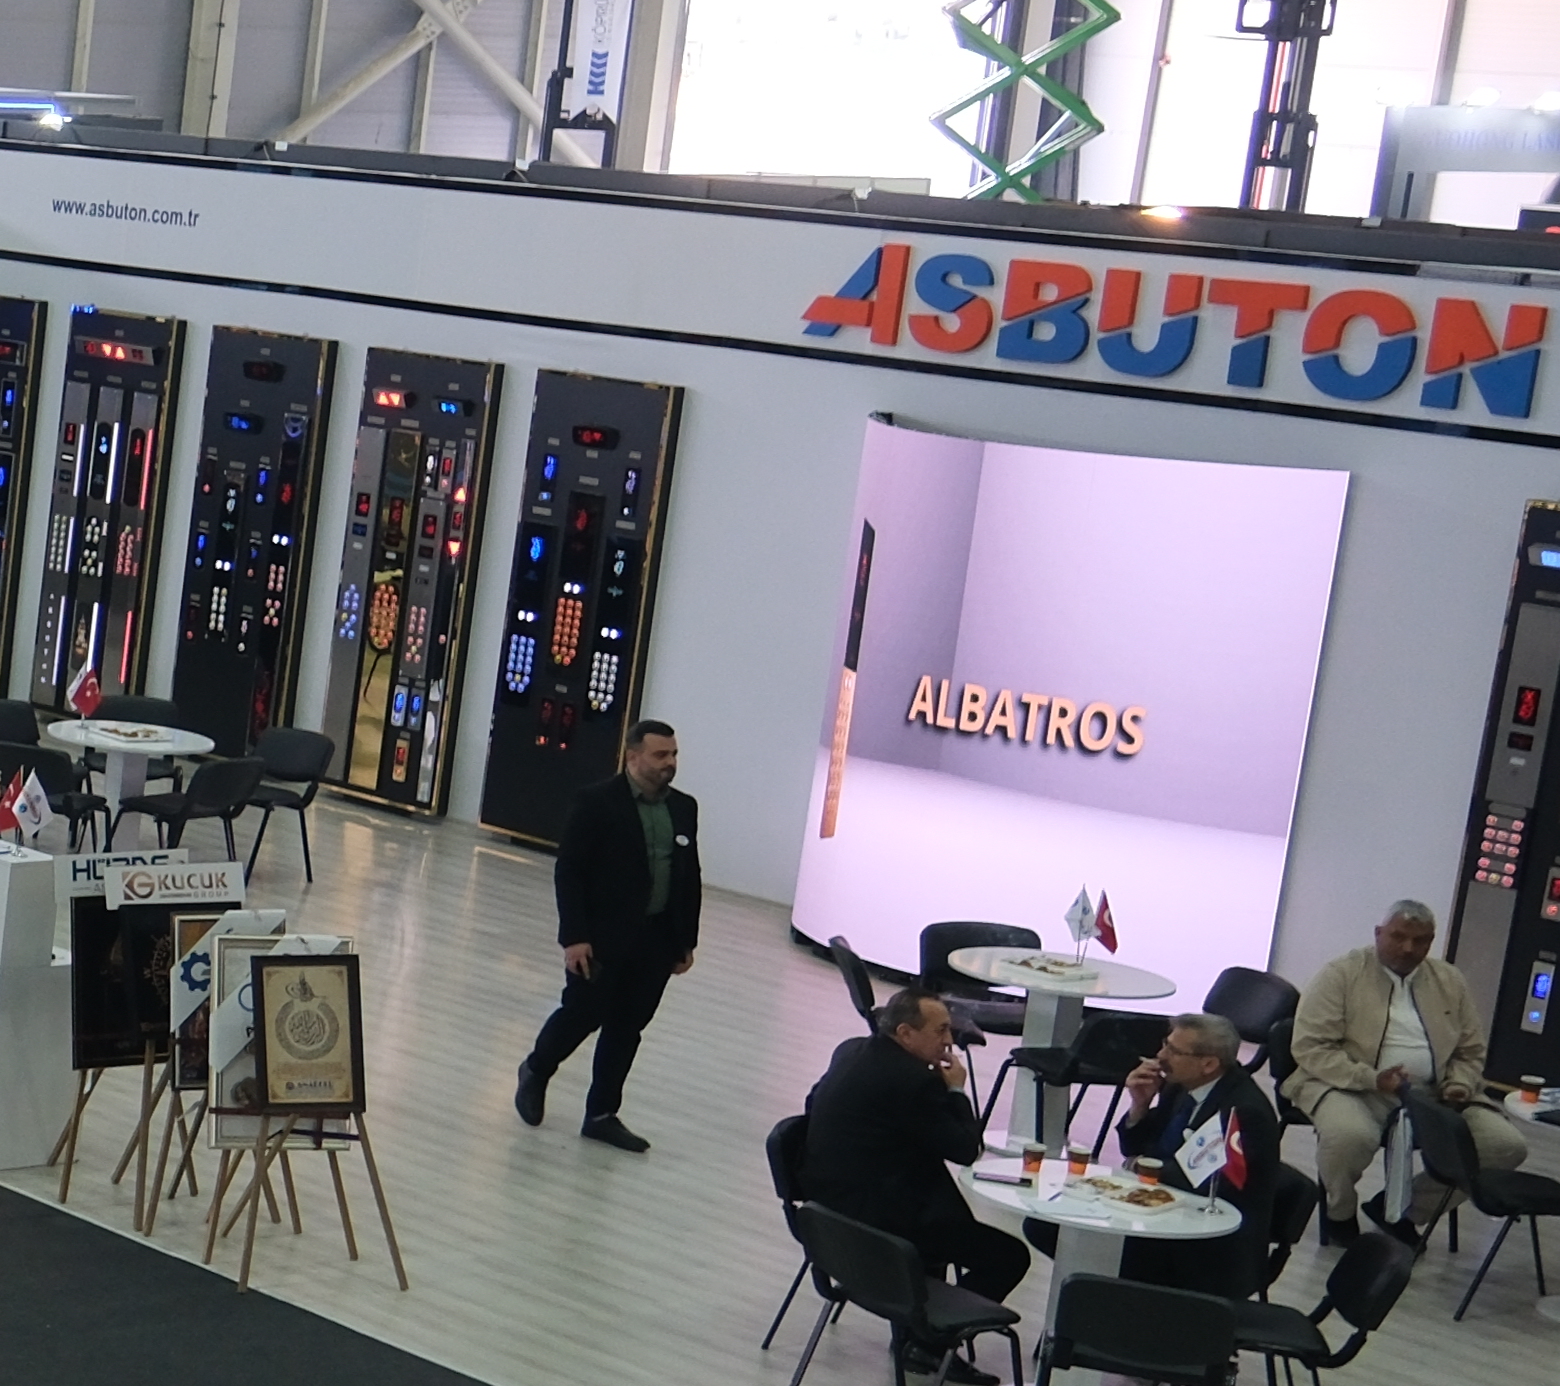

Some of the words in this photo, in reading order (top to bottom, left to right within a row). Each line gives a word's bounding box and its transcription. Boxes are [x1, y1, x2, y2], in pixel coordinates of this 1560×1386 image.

[51, 196, 201, 229] www.asbuton.com.tr
[800, 243, 1549, 419] ASBUTON
[906, 673, 1148, 758] ALBATROS
